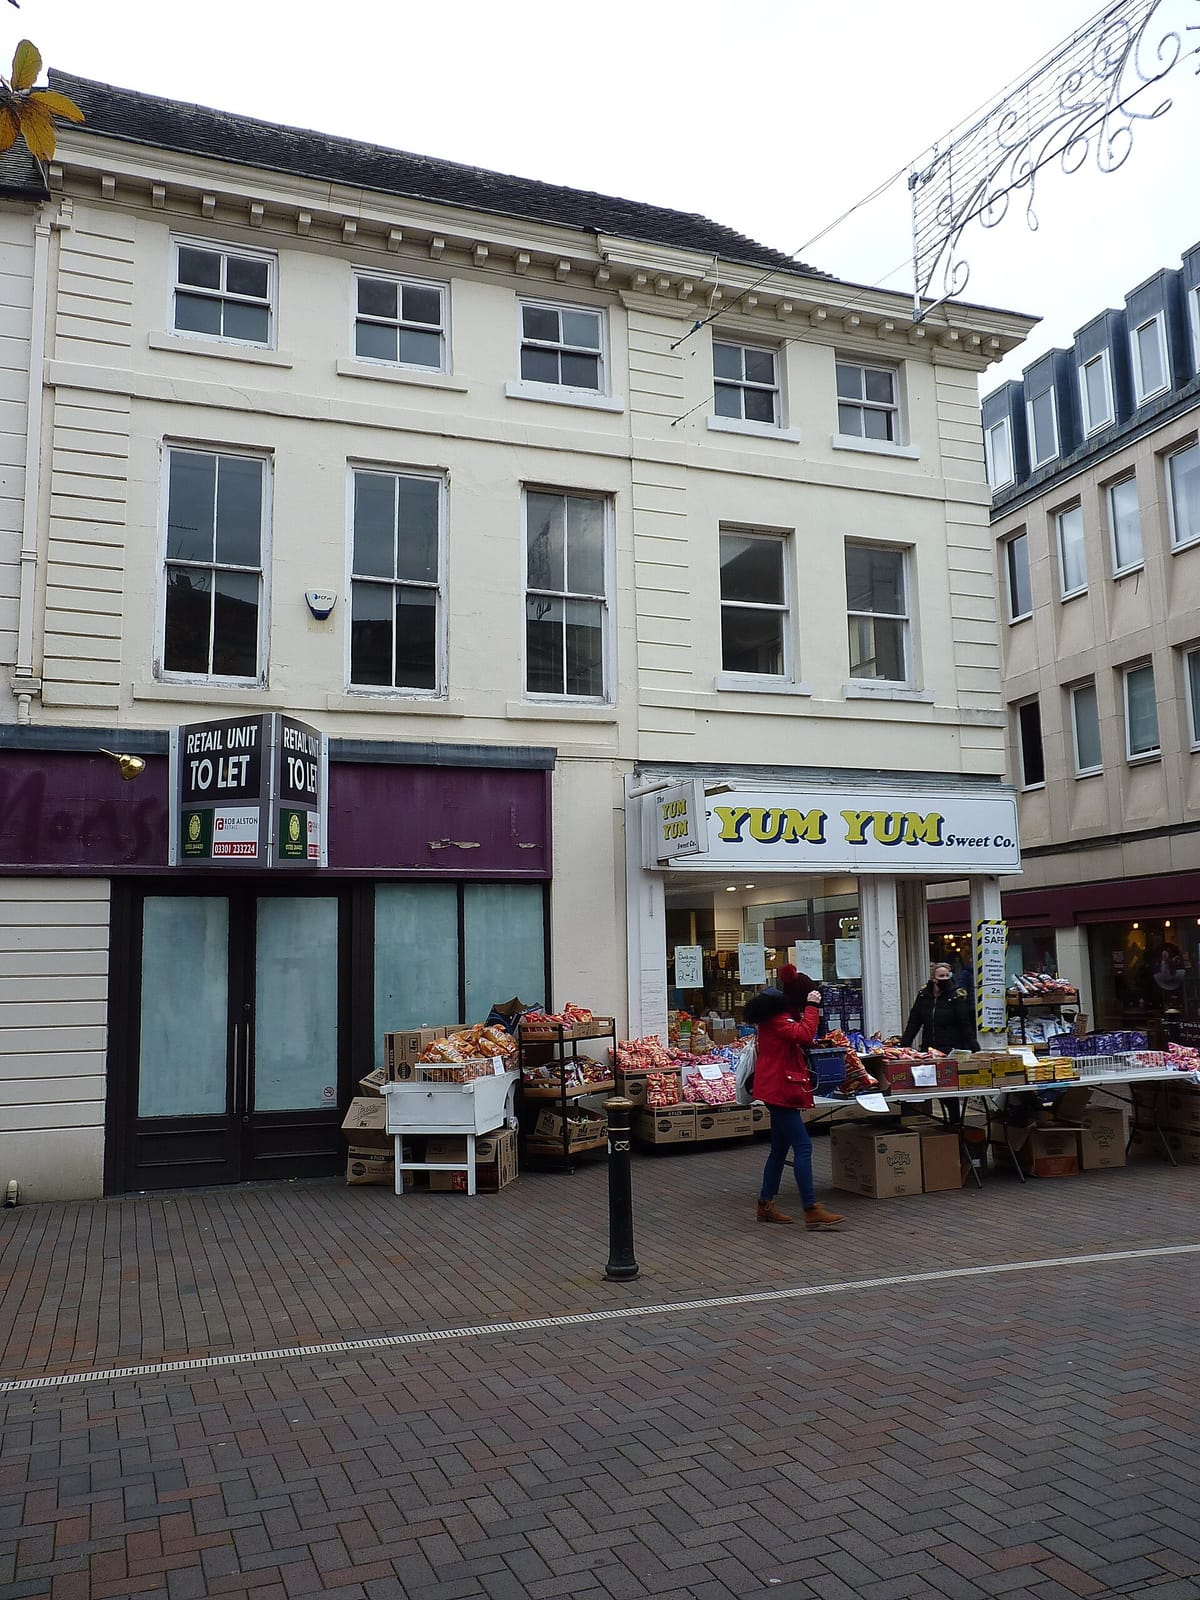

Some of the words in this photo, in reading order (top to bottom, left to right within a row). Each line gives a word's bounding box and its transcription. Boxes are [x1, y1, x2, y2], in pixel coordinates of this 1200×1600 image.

[187, 730, 223, 754] RETAIL
[227, 725, 258, 749] UNIT
[283, 726, 308, 755] RETAIL
[190, 758, 213, 791] TO
[217, 754, 250, 788] LET
[287, 756, 305, 791] TO
[235, 817, 258, 825] ALSTON
[661, 798, 687, 821] YUM
[663, 819, 689, 841] YUM
[713, 806, 828, 845] YUM
[840, 809, 945, 847] YUM
[945, 833, 989, 848] Sweet
[993, 834, 1016, 849] Co.
[214, 843, 231, 854] 03301
[232, 843, 256, 854] 233224
[984, 935, 1005, 945] SAFE
[985, 926, 1005, 935] STAY
